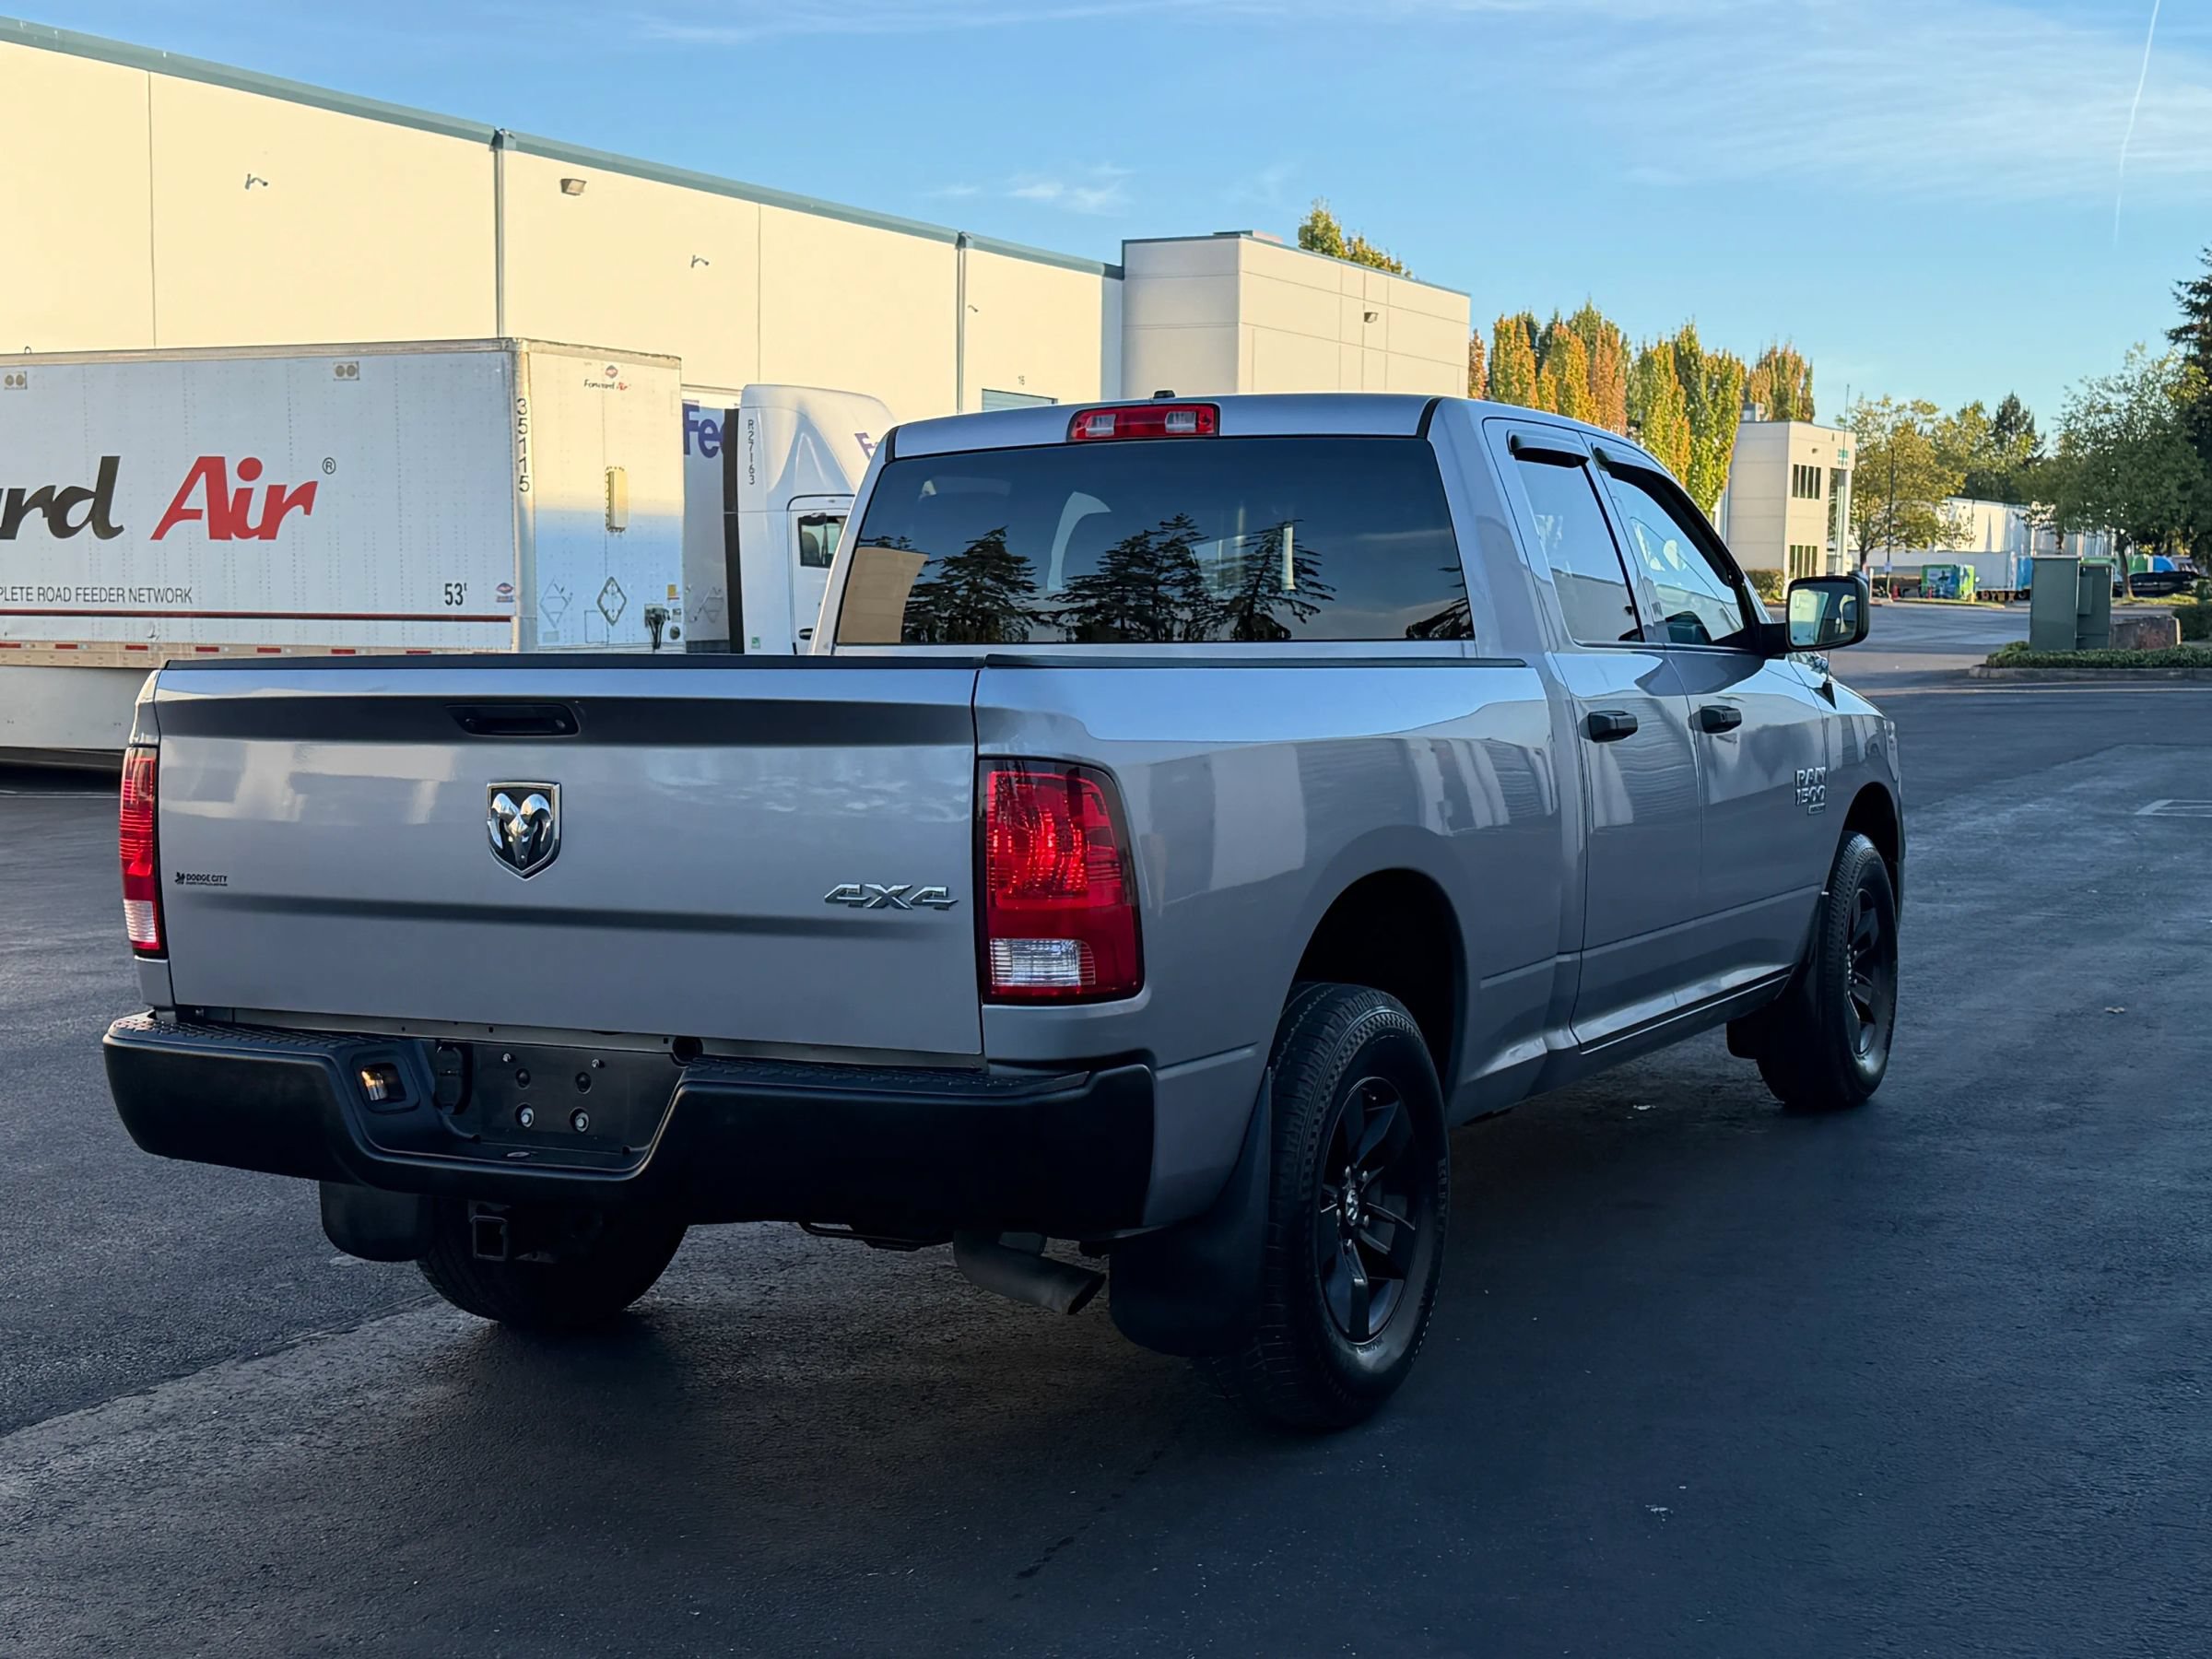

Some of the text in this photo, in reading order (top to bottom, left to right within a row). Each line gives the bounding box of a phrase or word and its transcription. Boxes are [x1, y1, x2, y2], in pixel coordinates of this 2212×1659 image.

[516, 397, 531, 493] 35115
[747, 418, 756, 486] R27163
[0, 456, 125, 540] rd
[37, 586, 72, 602] ROAD
[76, 587, 125, 603] FEEDER
[129, 587, 193, 604] NETWORK
[1794, 767, 1827, 787] RAM
[1794, 785, 1826, 806] 1500
[186, 874, 228, 883] DODGE CITY
